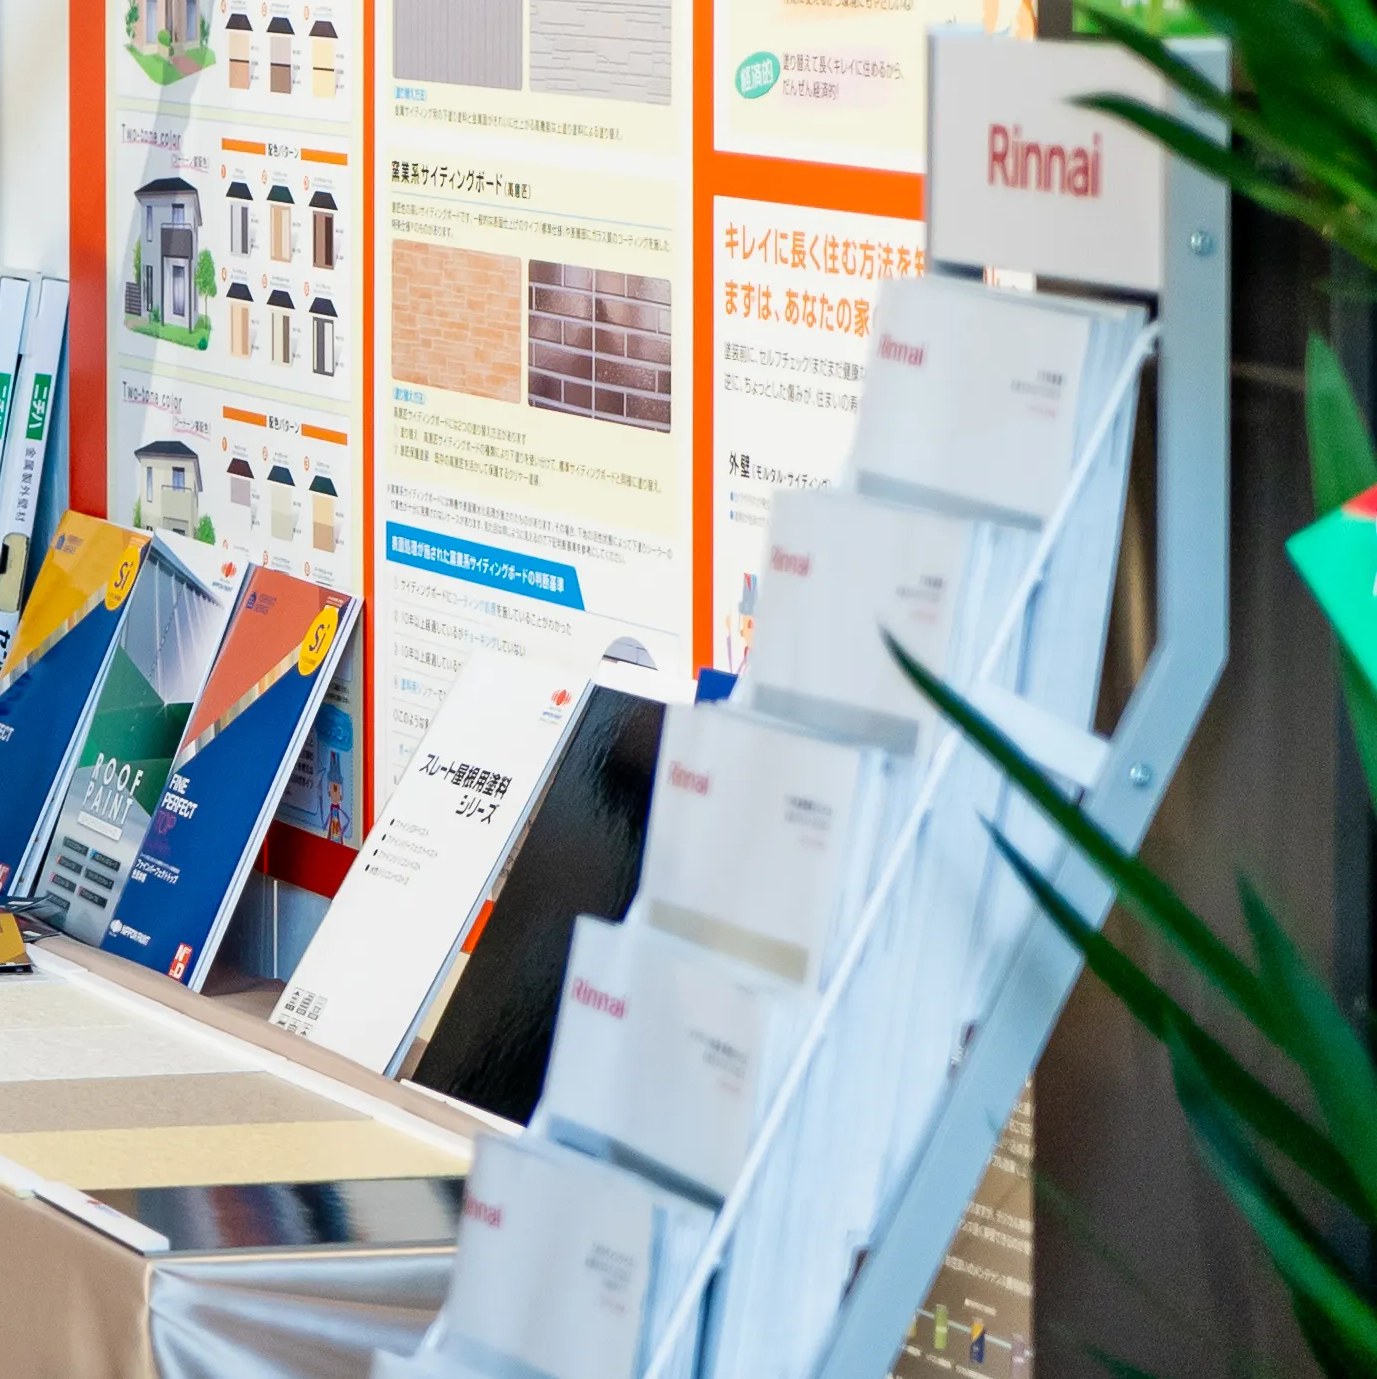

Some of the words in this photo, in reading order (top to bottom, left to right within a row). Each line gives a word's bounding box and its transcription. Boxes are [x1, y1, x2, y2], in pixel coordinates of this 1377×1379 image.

[740, 58, 774, 93] 経済的
[987, 123, 1101, 199] Rinnai
[724, 279, 872, 338] まずは、あなたの家
[29, 384, 48, 429] ニチハ
[14, 447, 37, 522] 金属製外壁材
[91, 751, 144, 796] ROOF
[168, 773, 190, 795] FINE
[418, 753, 513, 800] スレート屋根用塗料
[81, 780, 134, 825] PAINT
[161, 791, 198, 820] PERFECT
[455, 793, 500, 824] シリーズ
